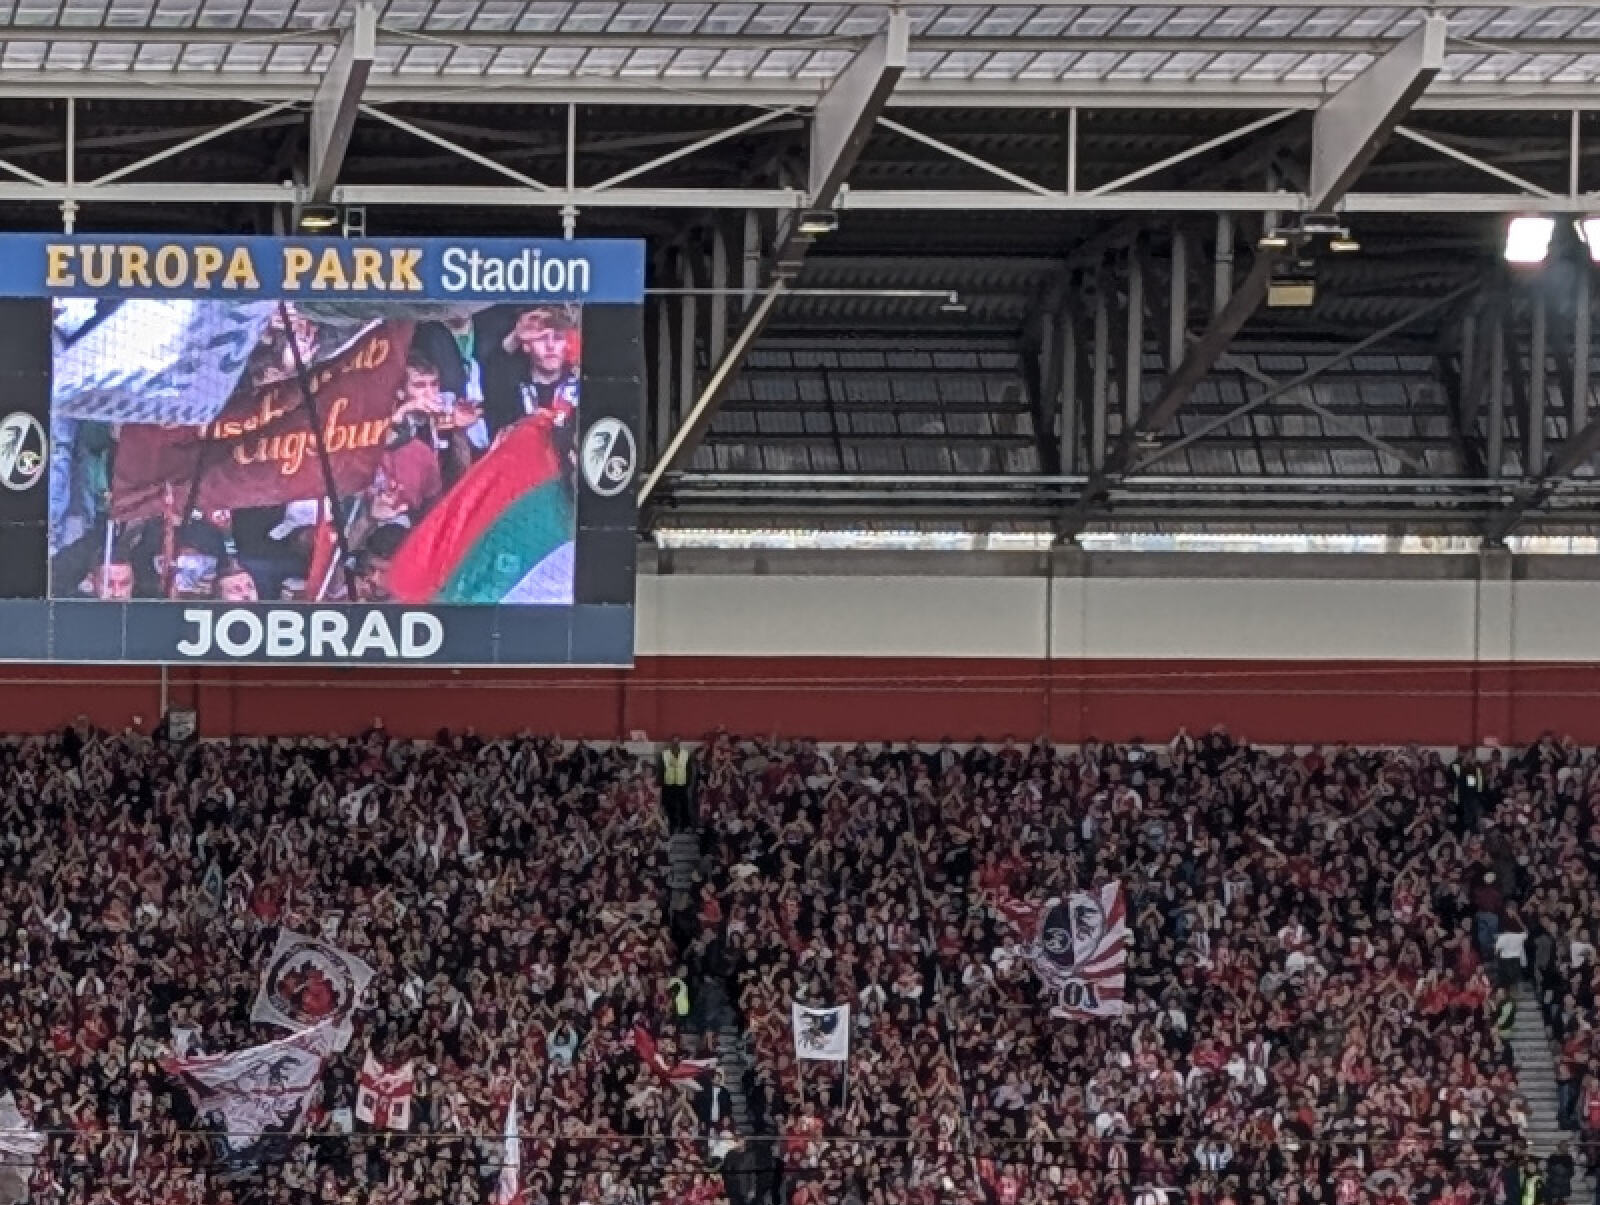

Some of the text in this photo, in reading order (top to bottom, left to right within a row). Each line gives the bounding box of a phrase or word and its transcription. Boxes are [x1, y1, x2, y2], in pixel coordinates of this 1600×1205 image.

[46, 244, 591, 294] EUROPA PARK Stadion
[177, 608, 445, 658] JOBRAD
